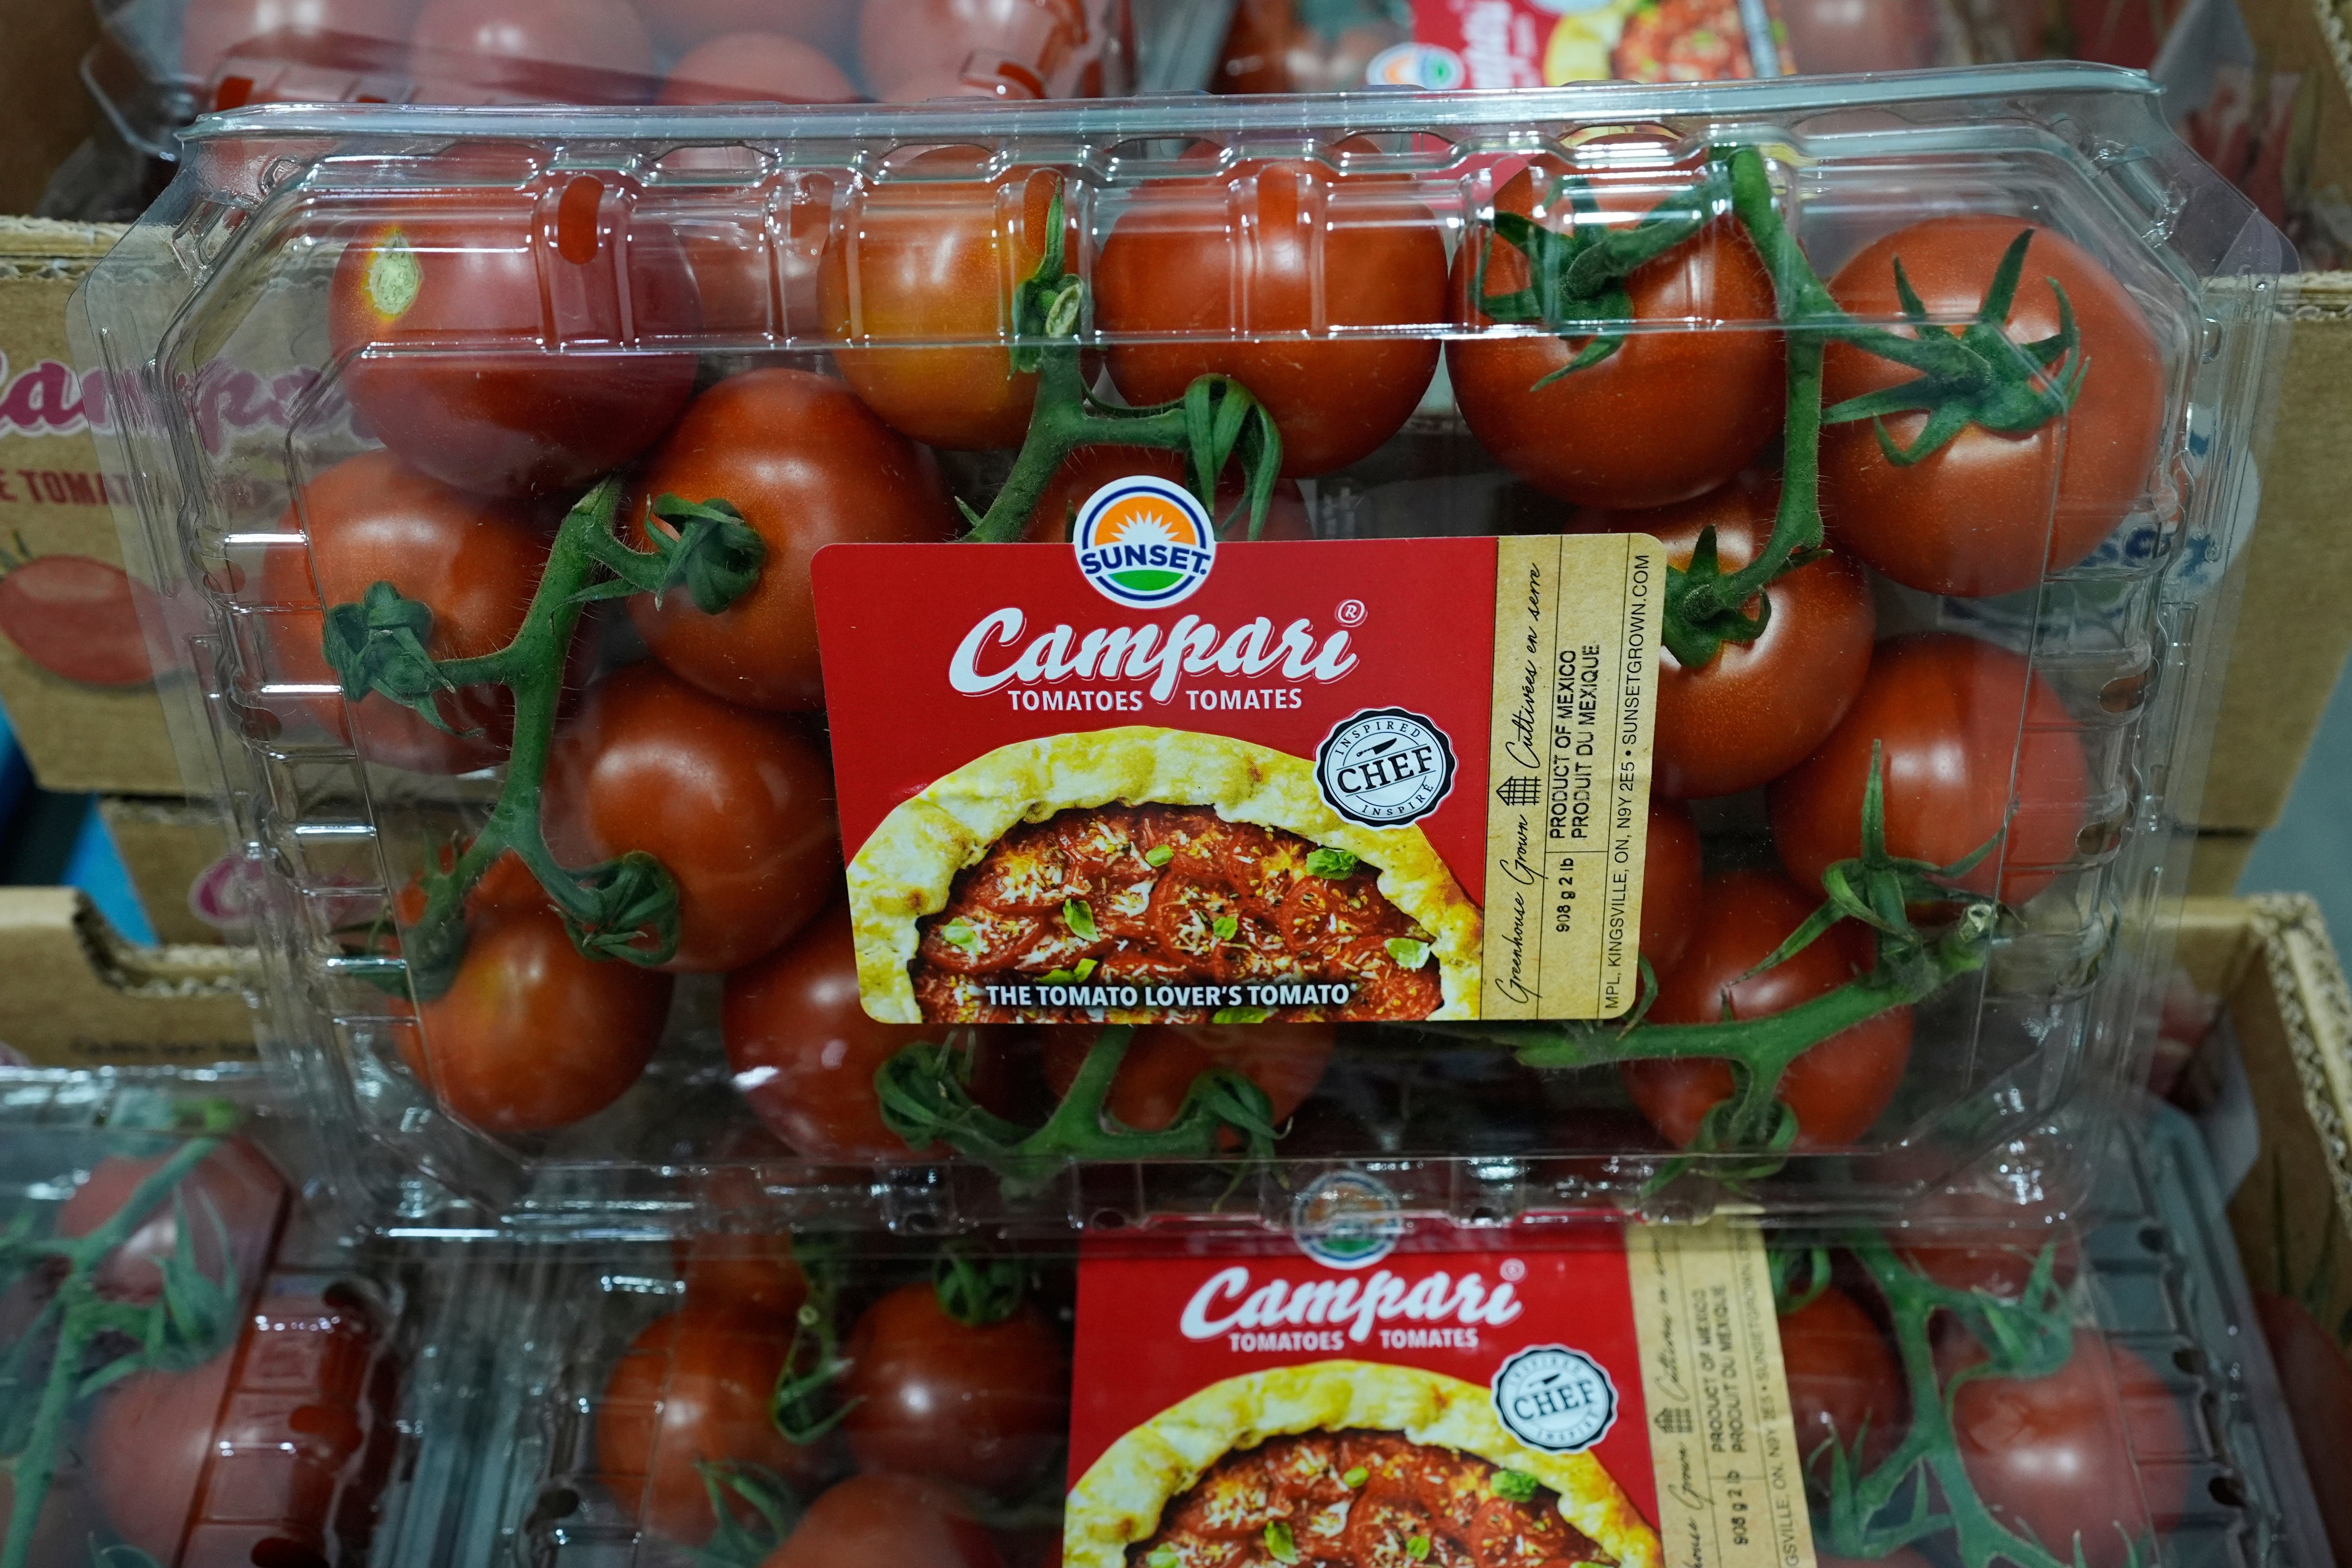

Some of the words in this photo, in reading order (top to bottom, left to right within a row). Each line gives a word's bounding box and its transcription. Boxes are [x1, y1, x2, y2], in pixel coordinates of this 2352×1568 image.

[1622, 554, 1650, 745] SUNSETGROWN.COM
[1008, 690, 1143, 712] TOMATOES
[1186, 688, 1303, 711] TOMATES
[1505, 660, 1540, 769] Cultivées
[1526, 627, 1538, 654] en
[1557, 650, 1576, 719] MEXICO
[1578, 644, 1600, 725] MEXIQUE
[1335, 721, 1421, 755] INSPIRED
[1555, 725, 1571, 749] OF
[1576, 732, 1594, 756] DU
[1338, 746, 1432, 793] CHEF
[1619, 762, 1635, 791] 2E5
[1362, 783, 1433, 816] INSPIRÉ
[1549, 754, 1570, 838] PRODUCT
[1571, 762, 1593, 838] PRODUIT
[1617, 797, 1632, 828] N9Y
[1499, 814, 1549, 885] Grown
[1559, 858, 1574, 868] lb
[1614, 835, 1632, 864] ON,
[1560, 876, 1573, 885] 2
[1561, 891, 1576, 900] g
[1556, 904, 1571, 932] 908
[1608, 870, 1629, 968] KINGSVILLE,
[1495, 892, 1542, 1004] Greenhouse
[986, 985, 1031, 1005] THE
[1037, 985, 1141, 1007] TOMATO
[1248, 982, 1350, 1005] TOMATO
[1605, 972, 1621, 1009] MPL,
[1229, 1330, 1344, 1352] TOMATOES
[1380, 1328, 1479, 1349] TOMATES
[1514, 1379, 1593, 1420] CHEF
